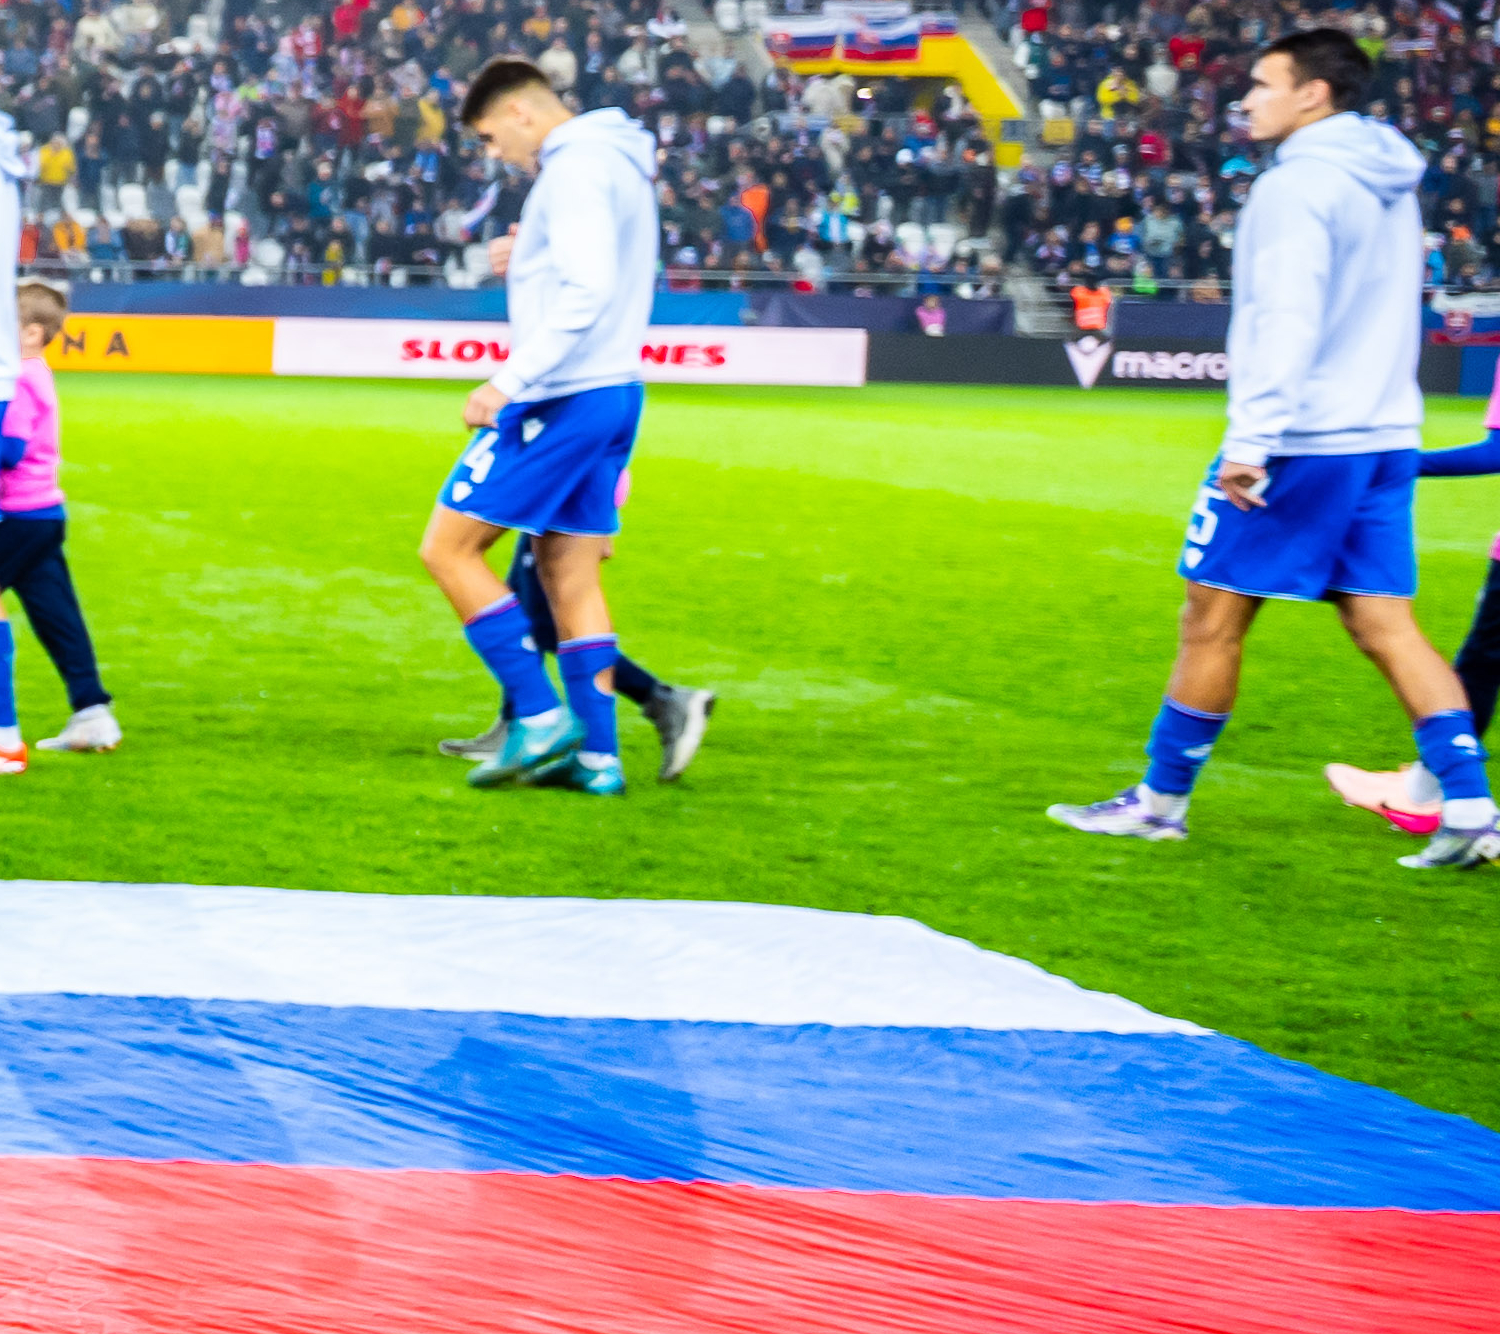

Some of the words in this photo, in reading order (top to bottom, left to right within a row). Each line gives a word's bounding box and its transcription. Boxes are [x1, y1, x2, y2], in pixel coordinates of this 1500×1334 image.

[402, 339, 510, 363] SLOV
[641, 344, 726, 367] NES
[1112, 351, 1229, 381] macro
[462, 430, 500, 485] 4
[1185, 486, 1228, 547] 5
